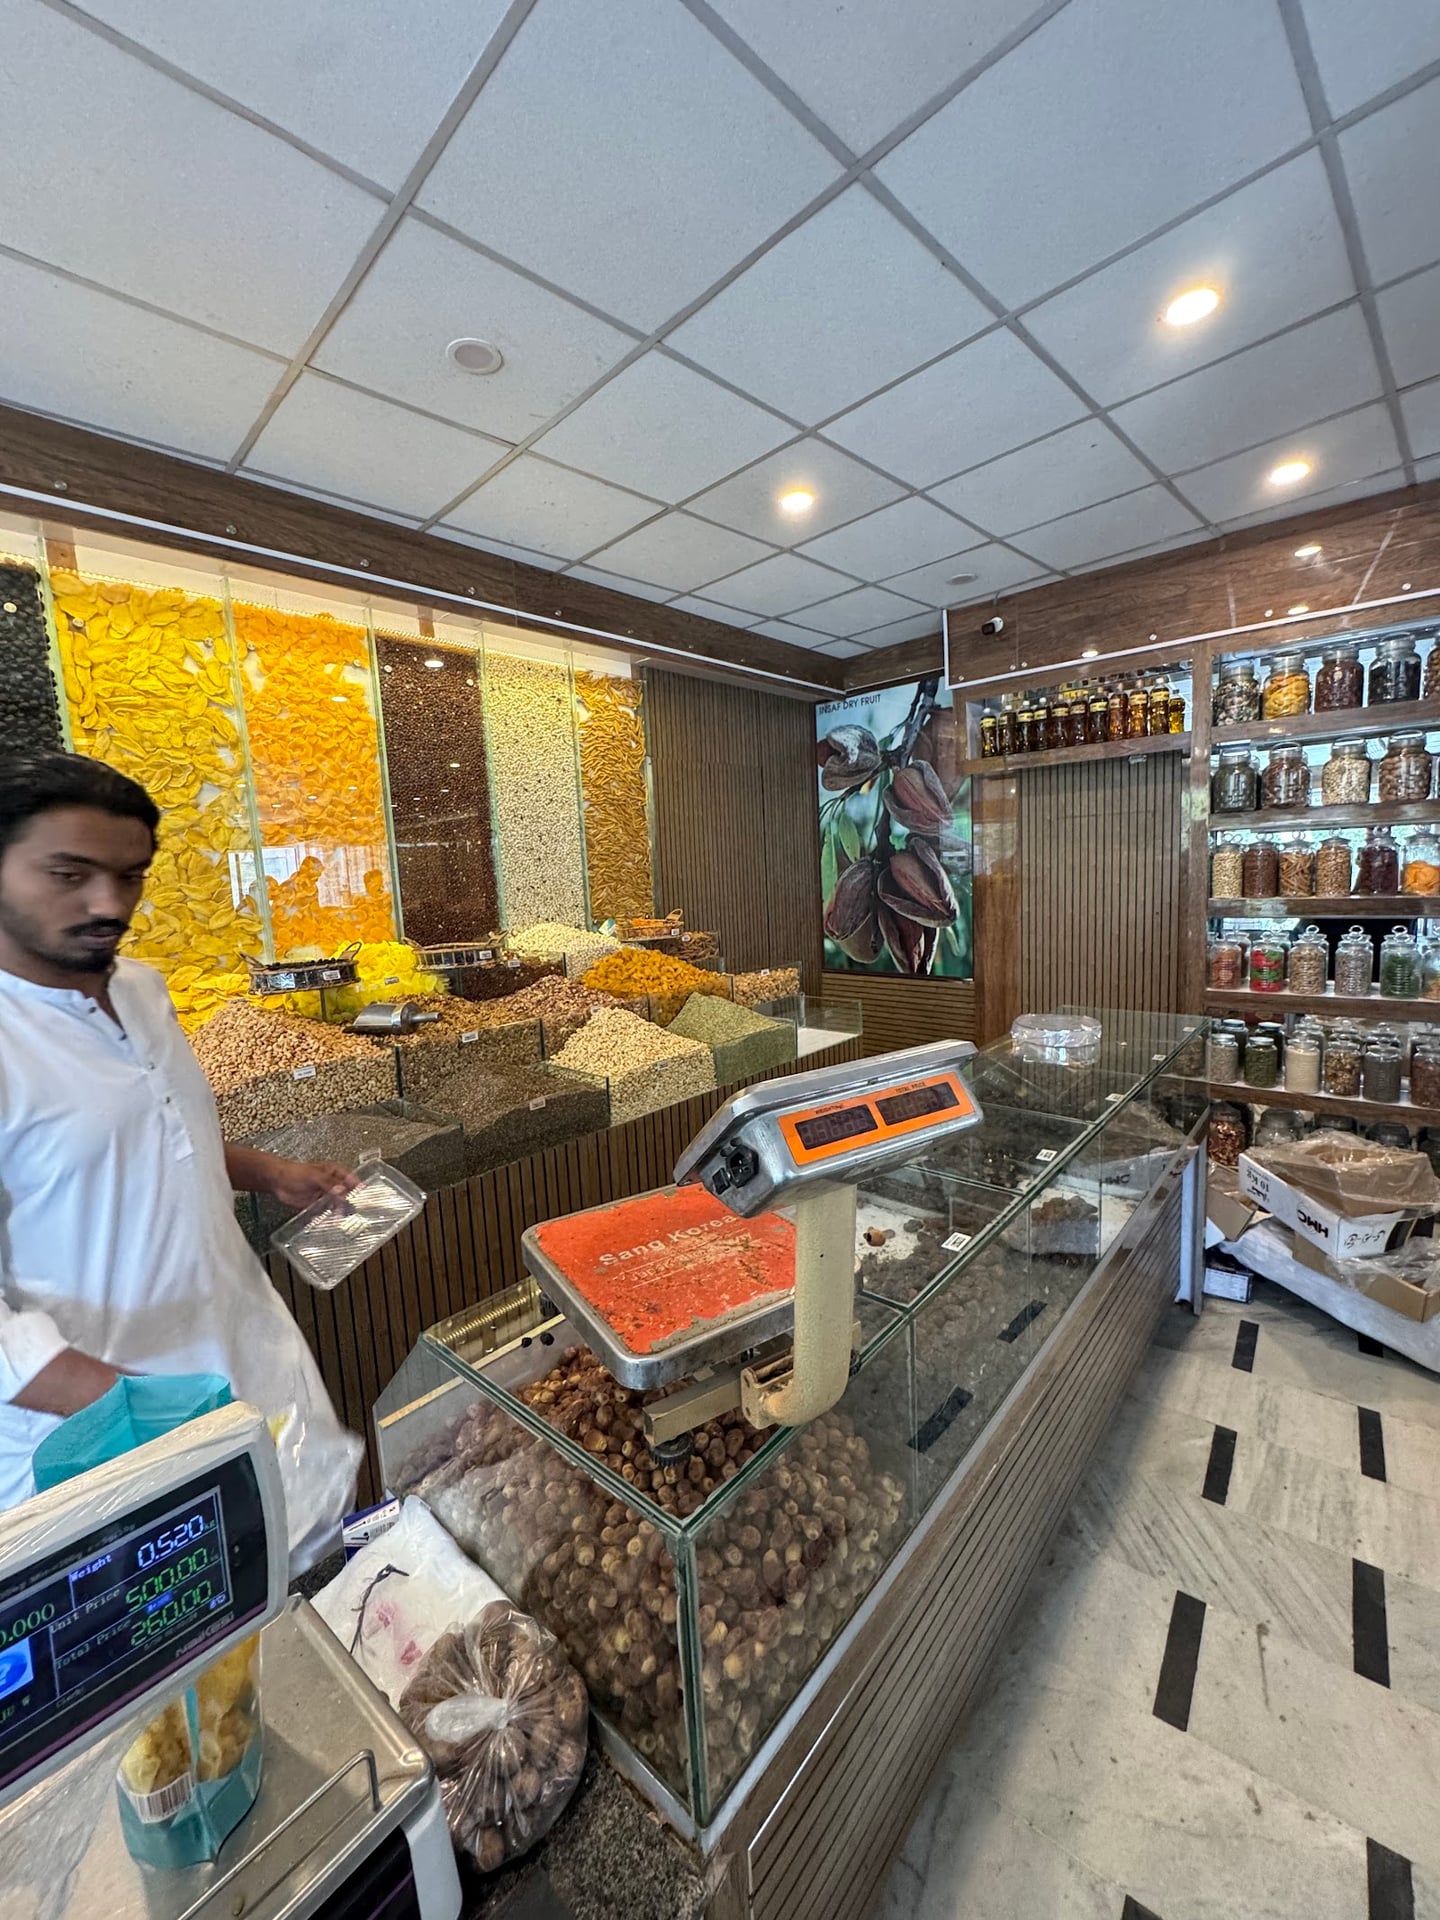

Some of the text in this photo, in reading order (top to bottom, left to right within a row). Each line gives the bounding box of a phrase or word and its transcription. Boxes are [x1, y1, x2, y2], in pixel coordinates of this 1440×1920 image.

[819, 694, 881, 715] INSAF DRY FRUIT
[599, 1239, 666, 1266] Sang
[667, 1214, 737, 1243] Korea
[1297, 1208, 1329, 1239] HMC
[69, 1554, 112, 1582] Weight
[137, 1514, 204, 1568] 0.520
[50, 1612, 80, 1634] Unit
[85, 1589, 120, 1614] Price
[124, 1547, 208, 1613] 500.00
[55, 1642, 90, 1670] Total
[96, 1619, 131, 1646] Price
[130, 1580, 212, 1646] 260.00
